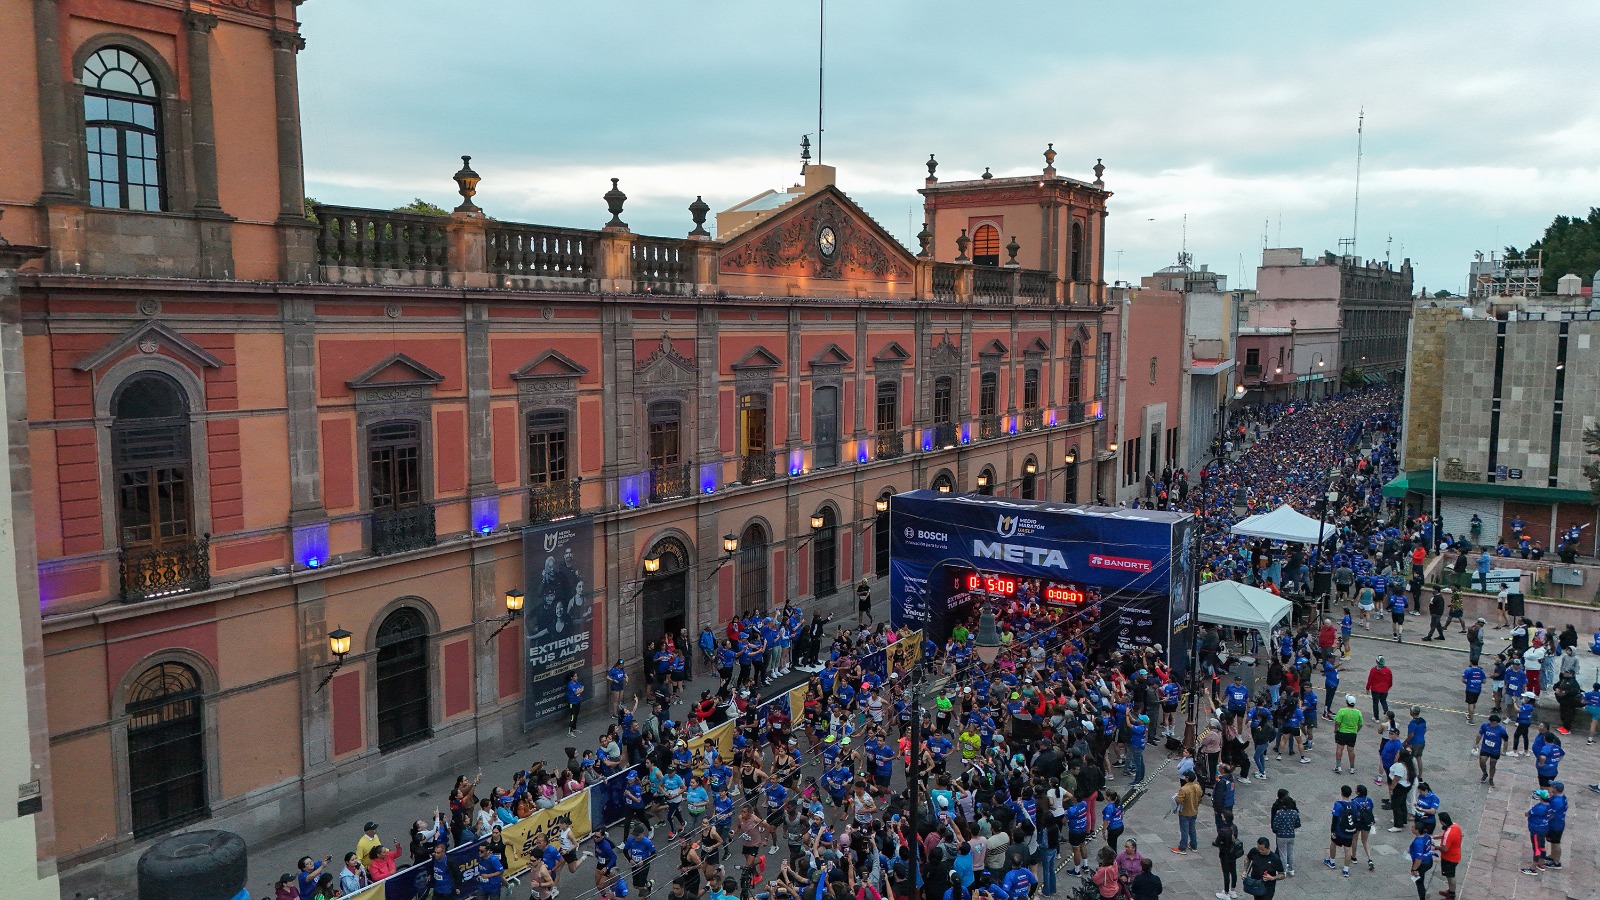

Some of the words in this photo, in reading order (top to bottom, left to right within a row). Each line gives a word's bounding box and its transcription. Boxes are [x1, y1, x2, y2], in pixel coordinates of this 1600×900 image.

[917, 530, 948, 542] BOSCH
[973, 539, 1068, 570] META
[1104, 559, 1150, 570] BANORTE
[529, 631, 590, 657] EXTIENDE
[530, 652, 556, 667] TUS
[559, 641, 590, 658] ALAS
[526, 824, 543, 840] LA
